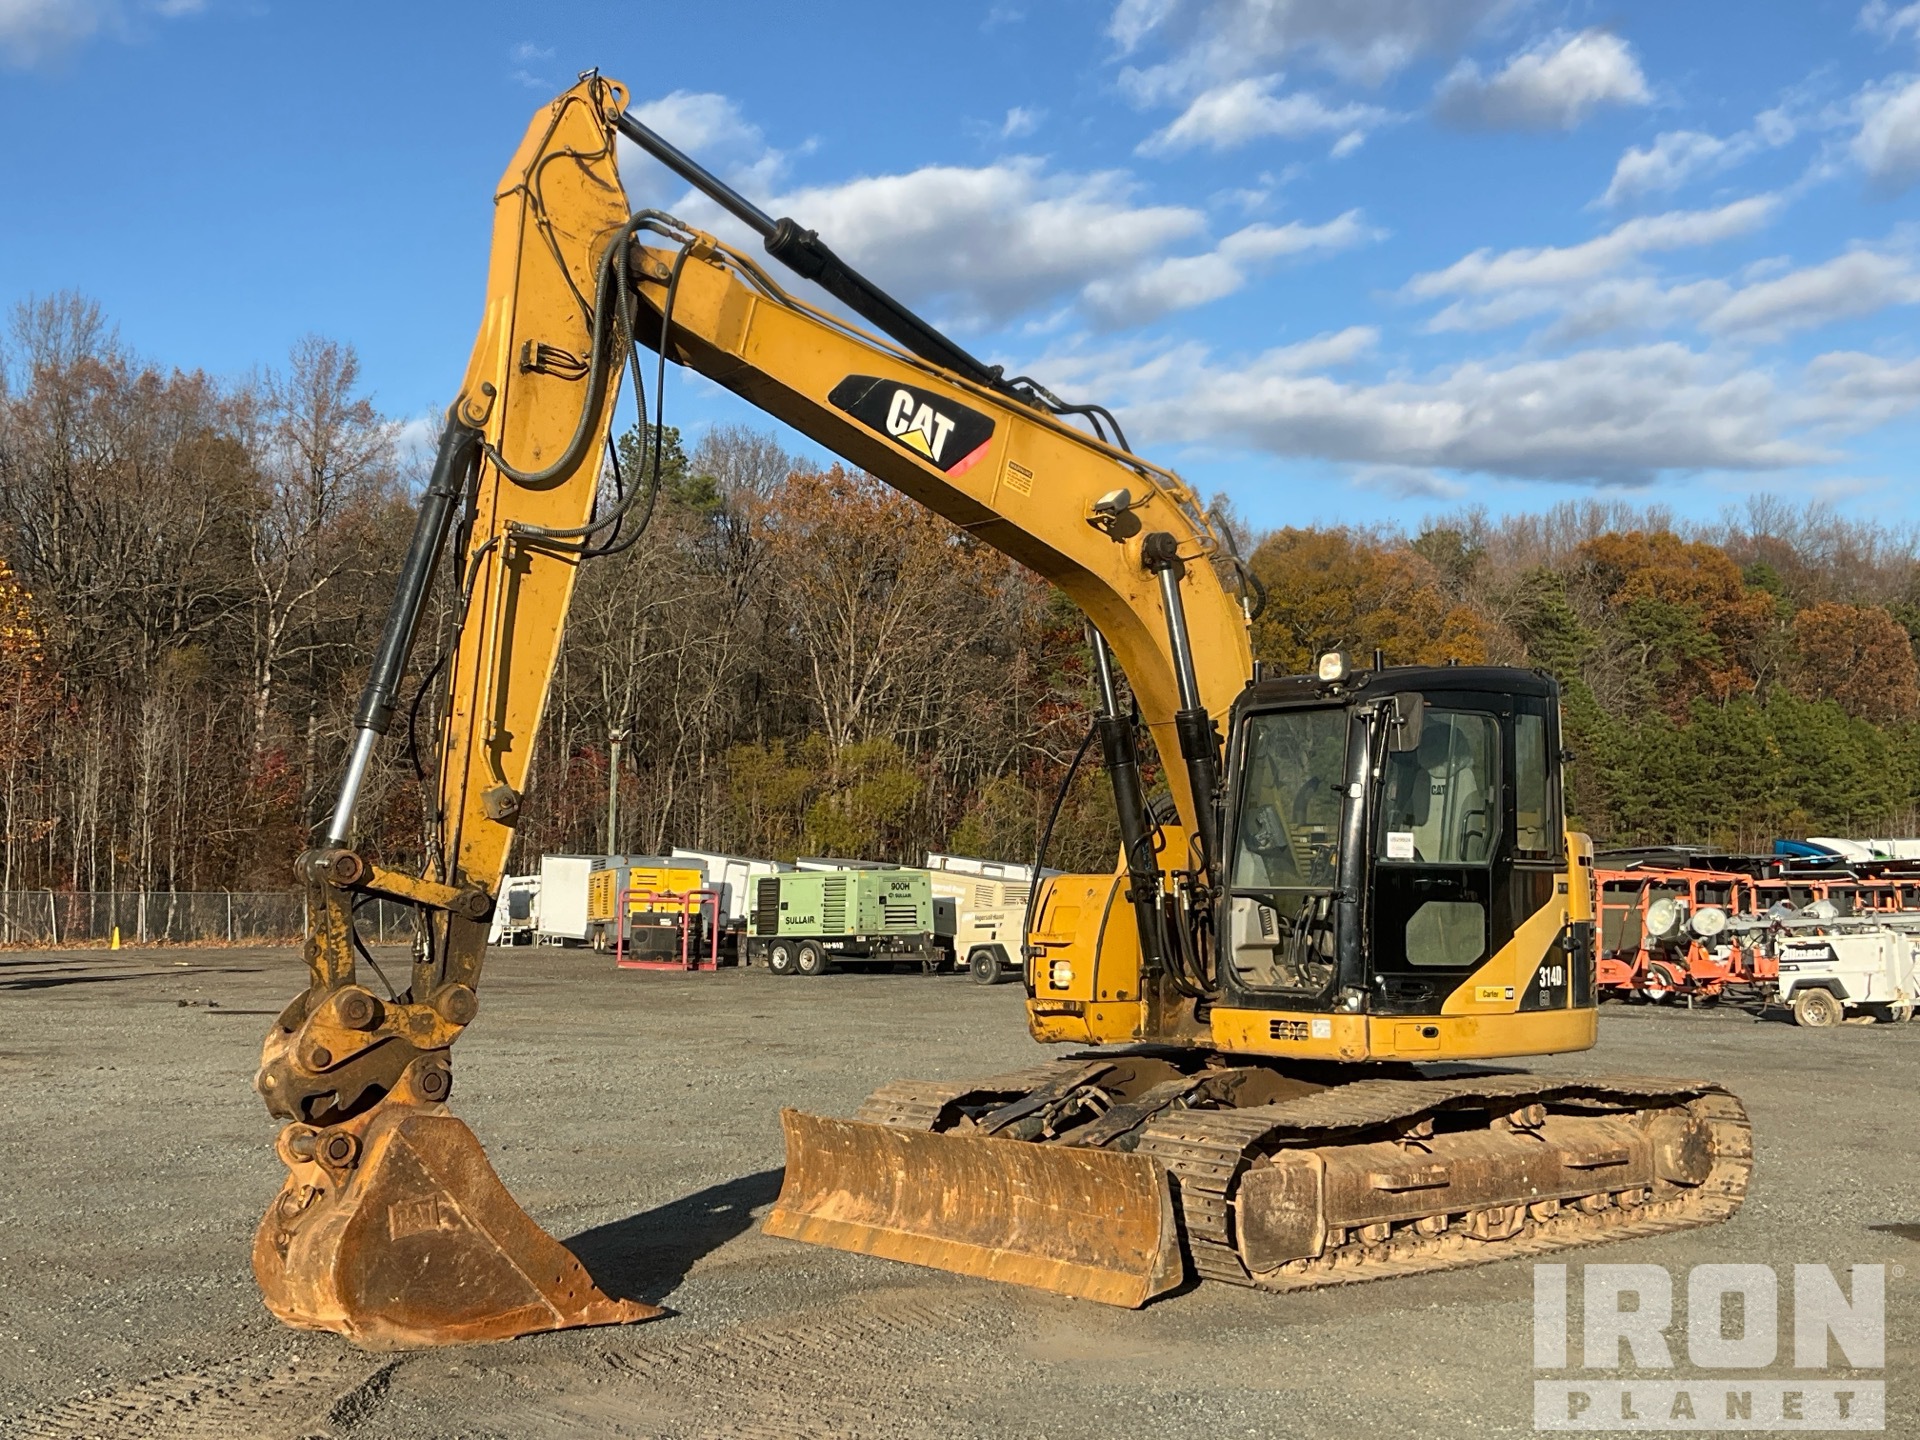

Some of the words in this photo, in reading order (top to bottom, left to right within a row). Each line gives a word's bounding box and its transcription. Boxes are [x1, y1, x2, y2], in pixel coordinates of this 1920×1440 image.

[886, 389, 955, 462] CAT
[1432, 785, 1446, 795] CAT
[891, 883, 910, 891] 900H
[785, 916, 815, 925] SULLAIR
[1539, 966, 1562, 987] 314D
[1482, 989, 1499, 998] Carter
